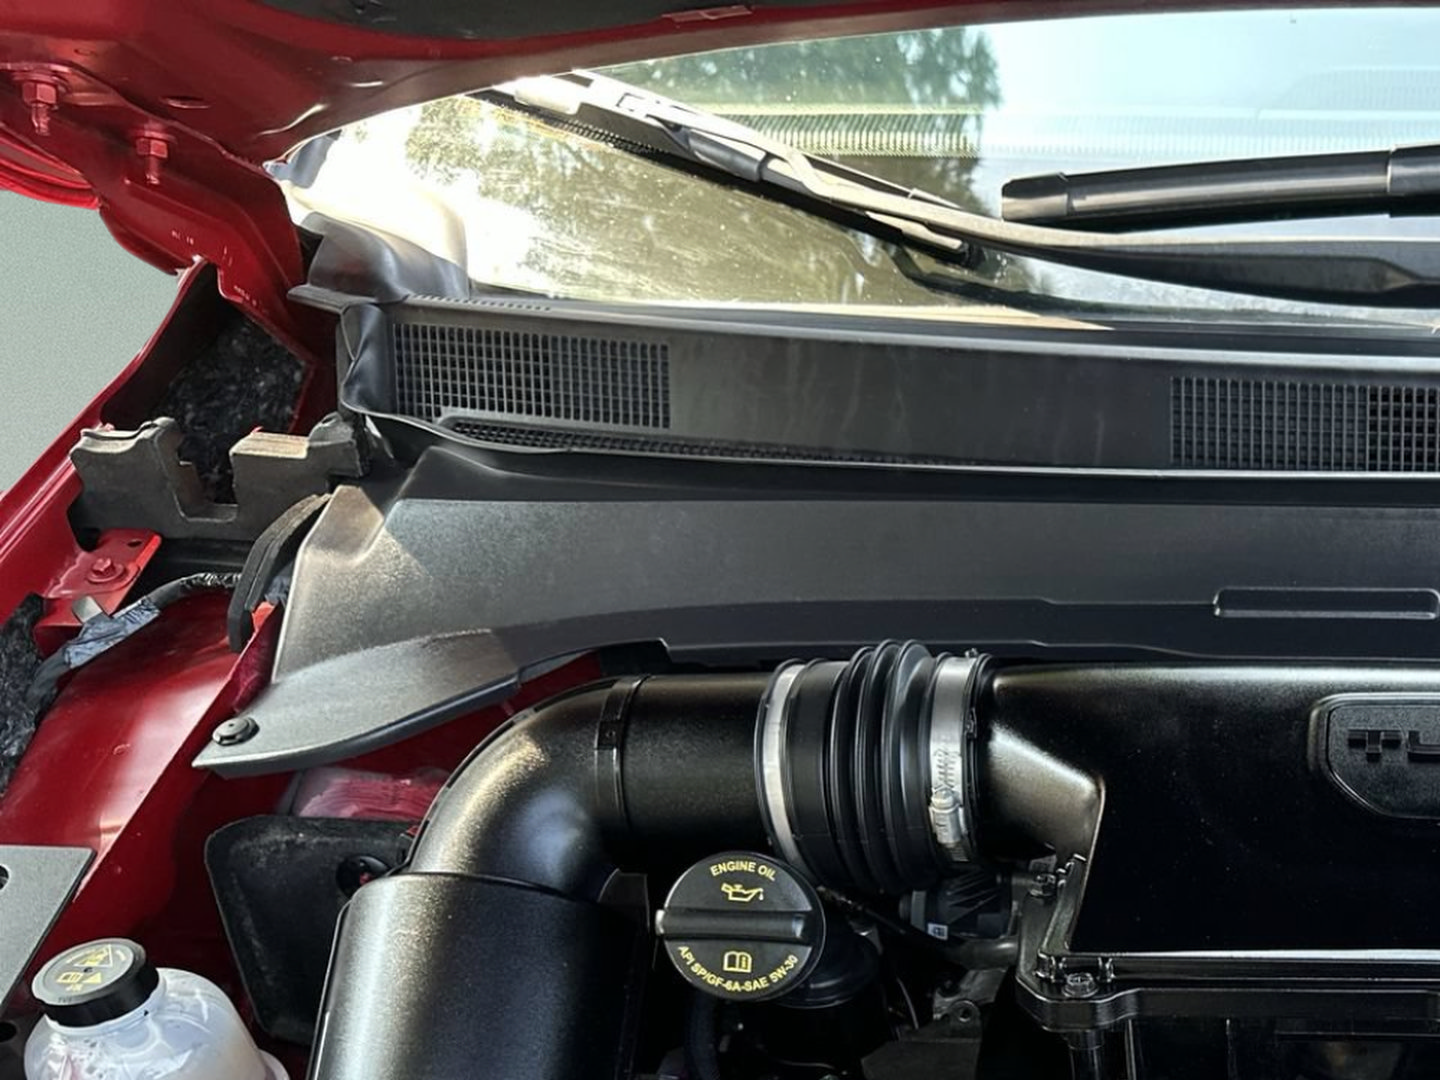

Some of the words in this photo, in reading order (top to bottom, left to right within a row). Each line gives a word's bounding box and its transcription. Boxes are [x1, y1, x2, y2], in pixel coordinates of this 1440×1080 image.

[710, 861, 757, 877] ENGINE
[758, 865, 777, 882] OIL
[678, 945, 695, 966] API
[769, 954, 799, 984] 5W-30
